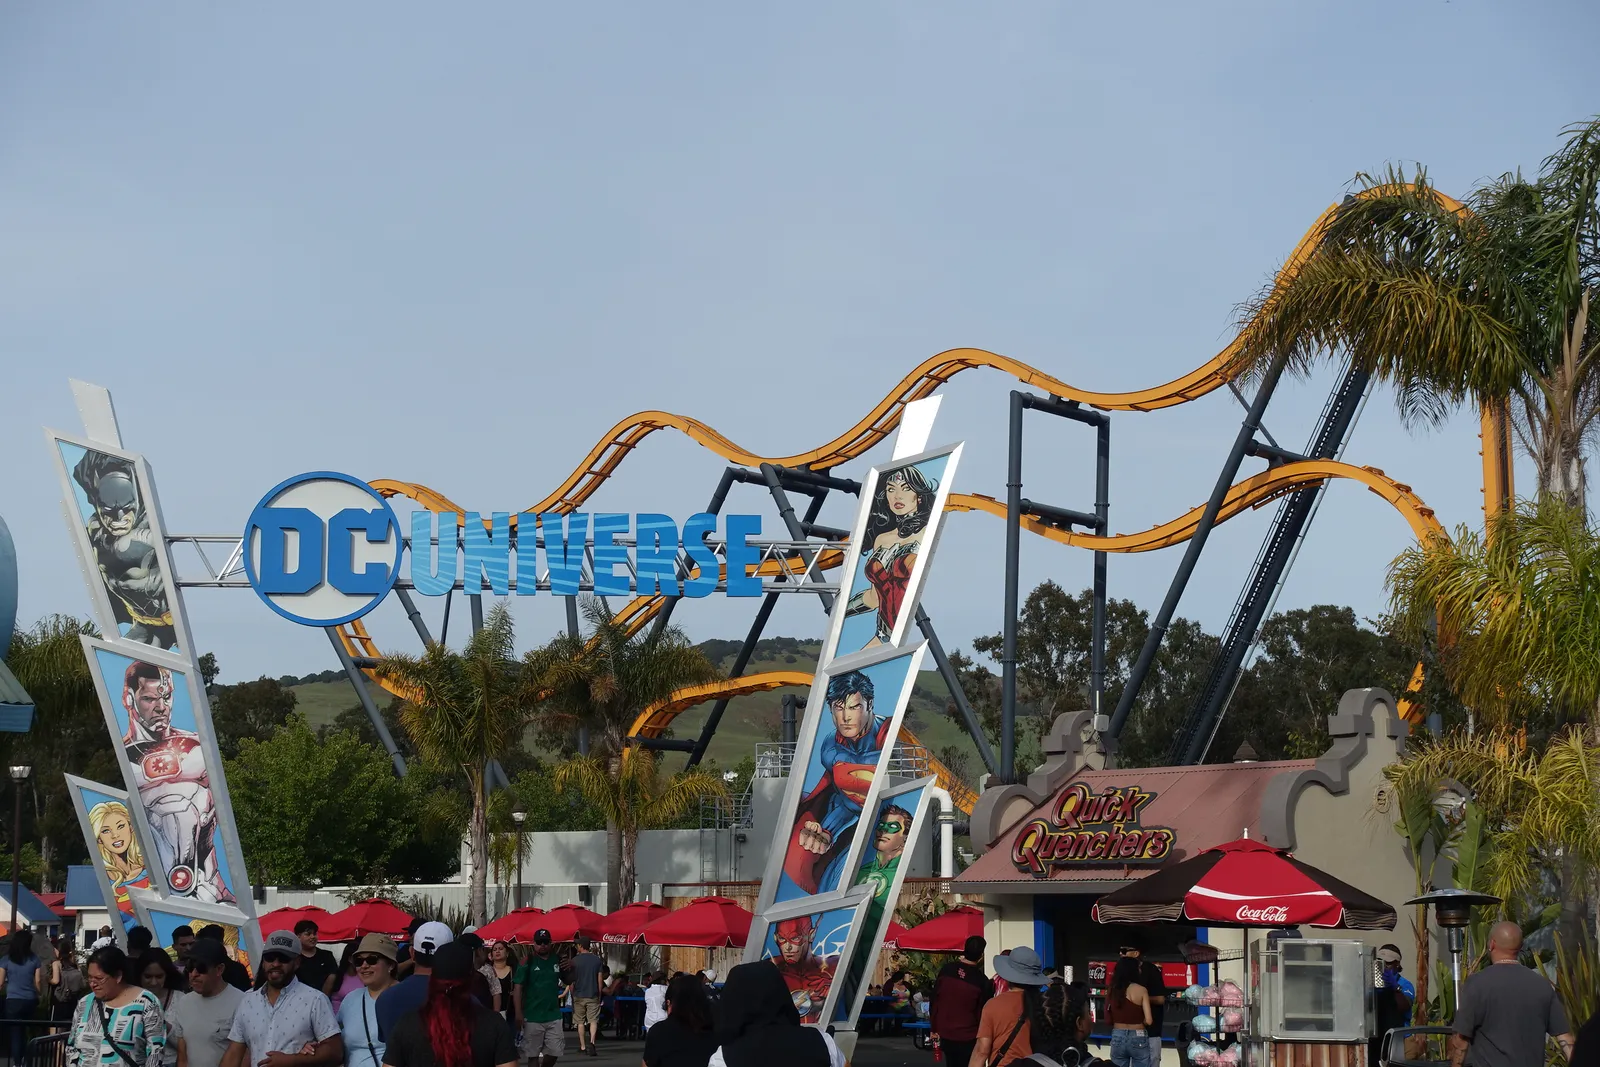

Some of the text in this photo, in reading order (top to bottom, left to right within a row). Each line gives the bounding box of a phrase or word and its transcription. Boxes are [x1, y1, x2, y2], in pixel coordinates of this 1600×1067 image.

[252, 508, 763, 598] DC UNIVERSE
[1051, 785, 1149, 830] Quick
[1012, 824, 1173, 874] Quenchers
[1236, 904, 1290, 922] Coca-Cola
